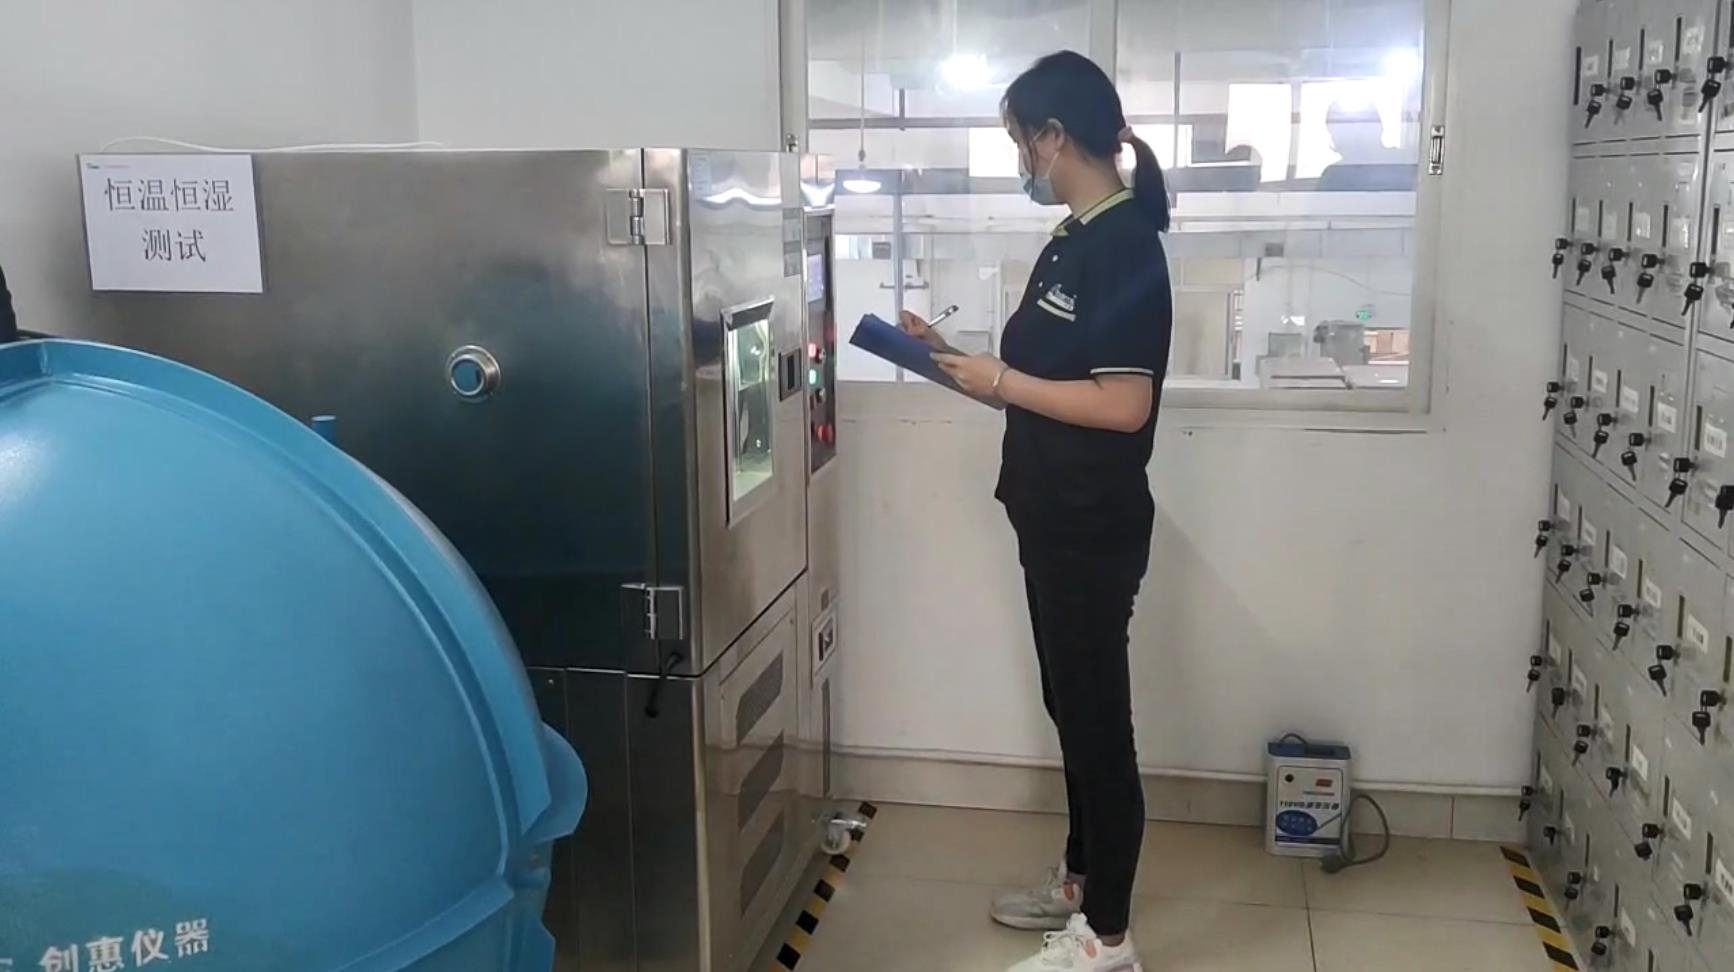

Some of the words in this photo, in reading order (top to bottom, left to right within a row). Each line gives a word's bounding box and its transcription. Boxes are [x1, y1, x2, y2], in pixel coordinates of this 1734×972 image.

[104, 177, 235, 212] 恒温恒湿
[142, 229, 207, 262] 测试
[39, 918, 209, 972] 创惠仪器
